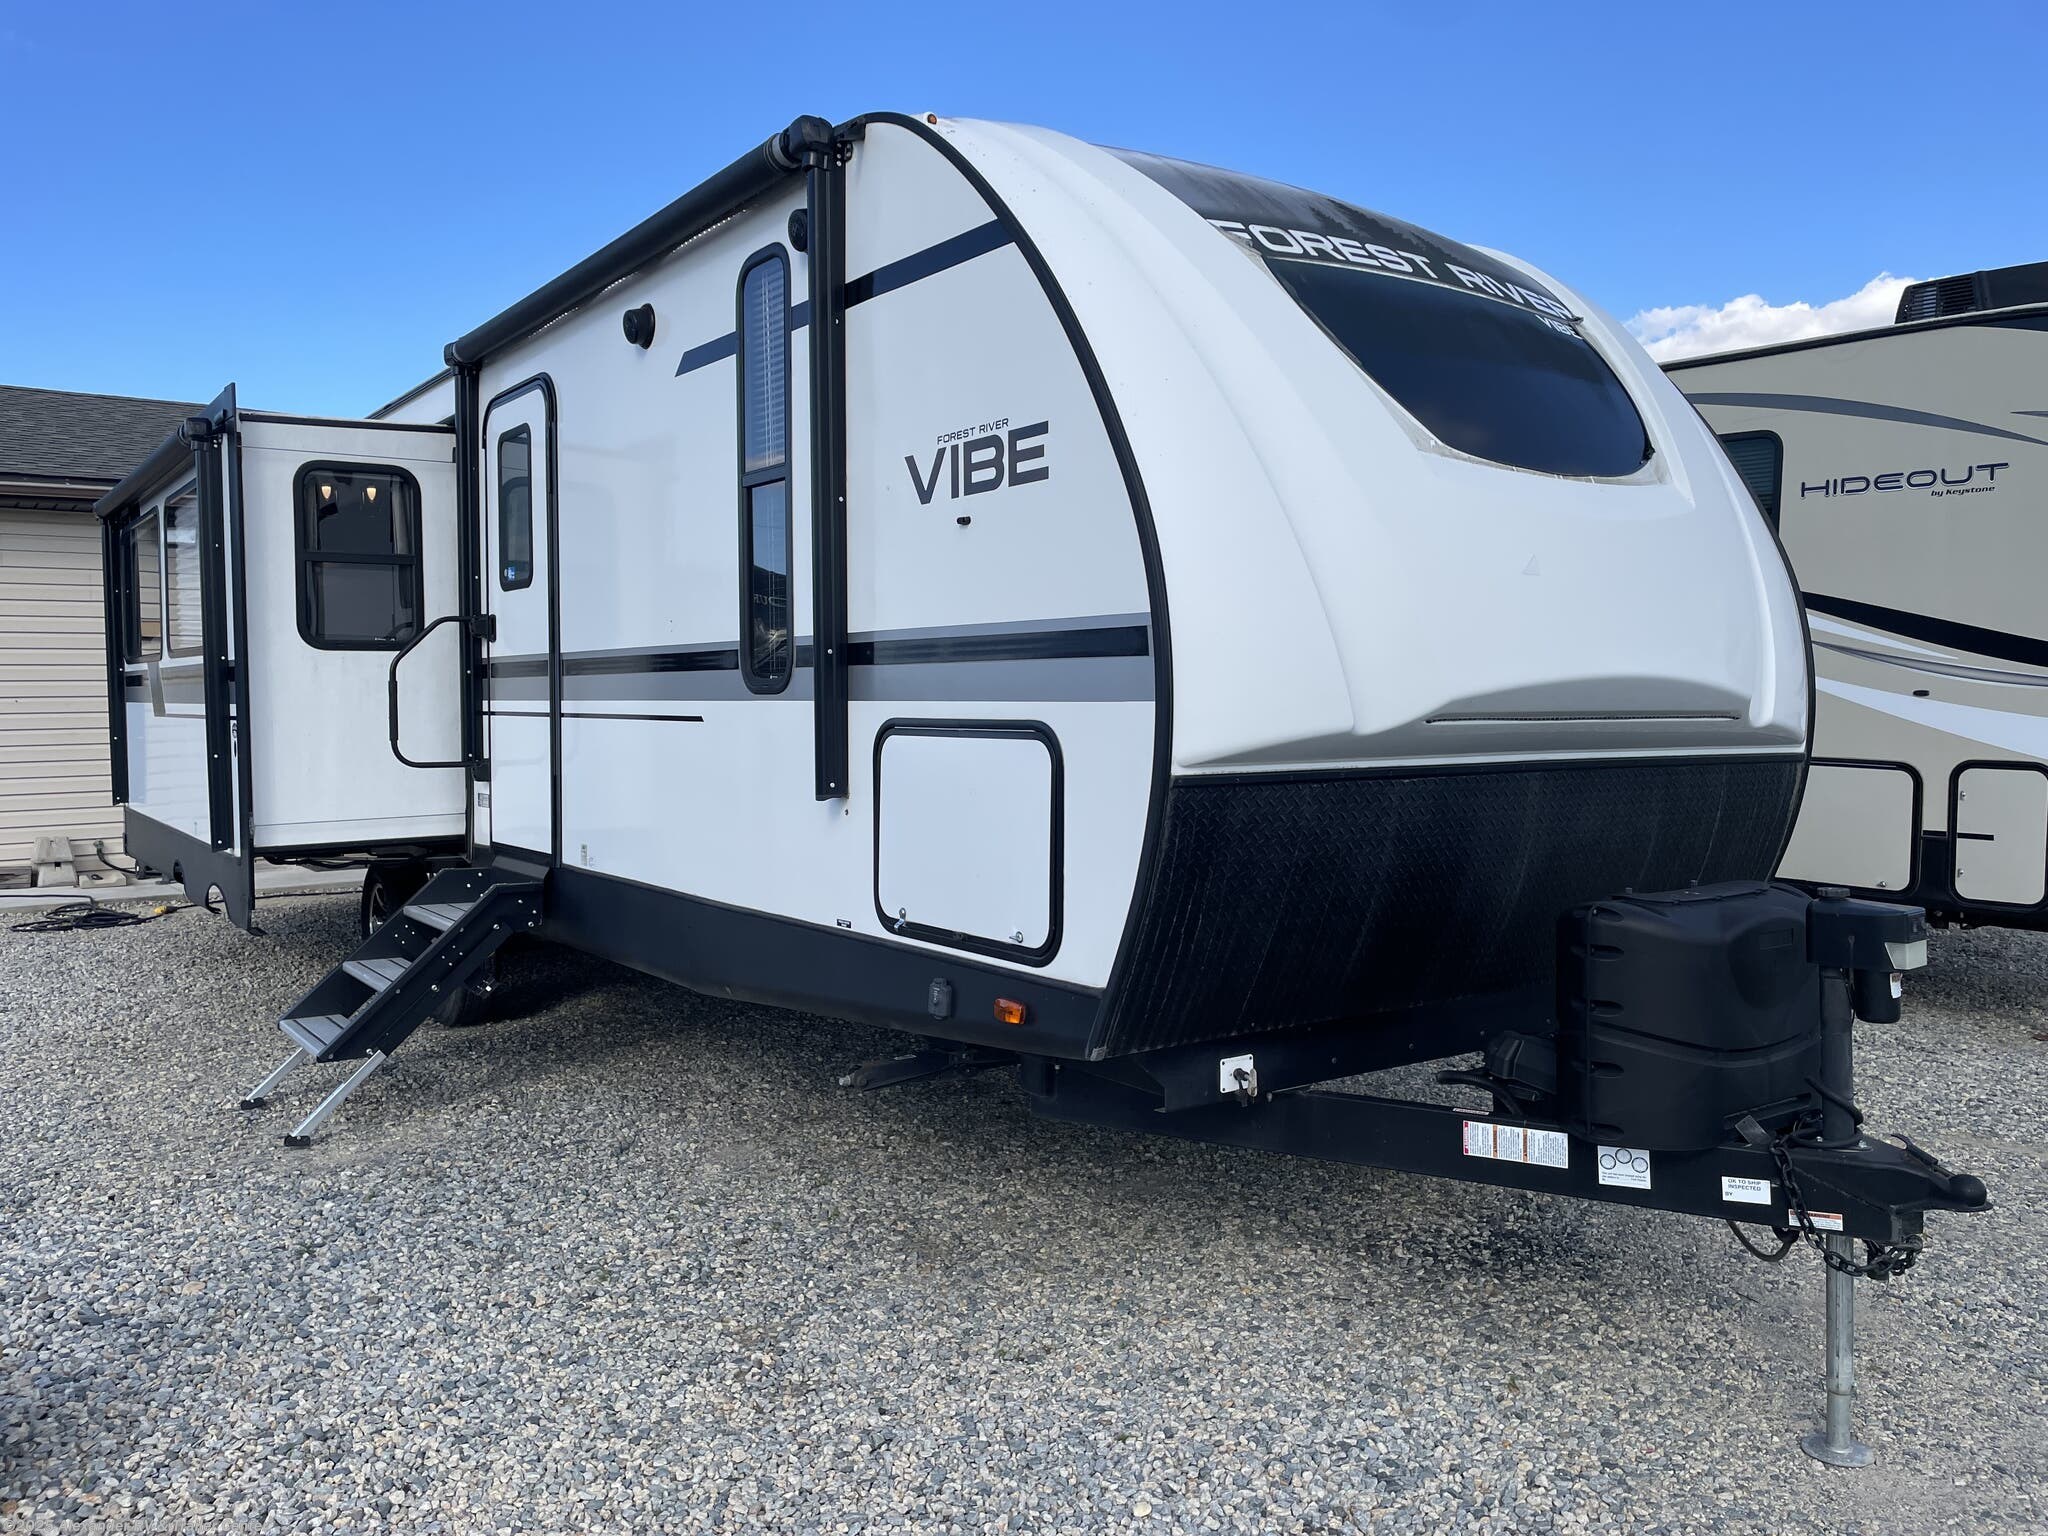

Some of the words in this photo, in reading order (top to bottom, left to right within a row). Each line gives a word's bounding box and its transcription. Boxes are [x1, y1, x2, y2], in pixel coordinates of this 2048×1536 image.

[1206, 218, 1438, 279] FOREST
[1446, 262, 1573, 319] RIVER
[1535, 314, 1583, 340] VIBE
[936, 426, 976, 446] FOREST
[979, 417, 1009, 434] RIVER
[904, 420, 1049, 505] VIBE
[1800, 462, 2009, 499] HIDEOUT
[1930, 489, 1944, 498] by
[1945, 486, 1996, 496] Keystone
